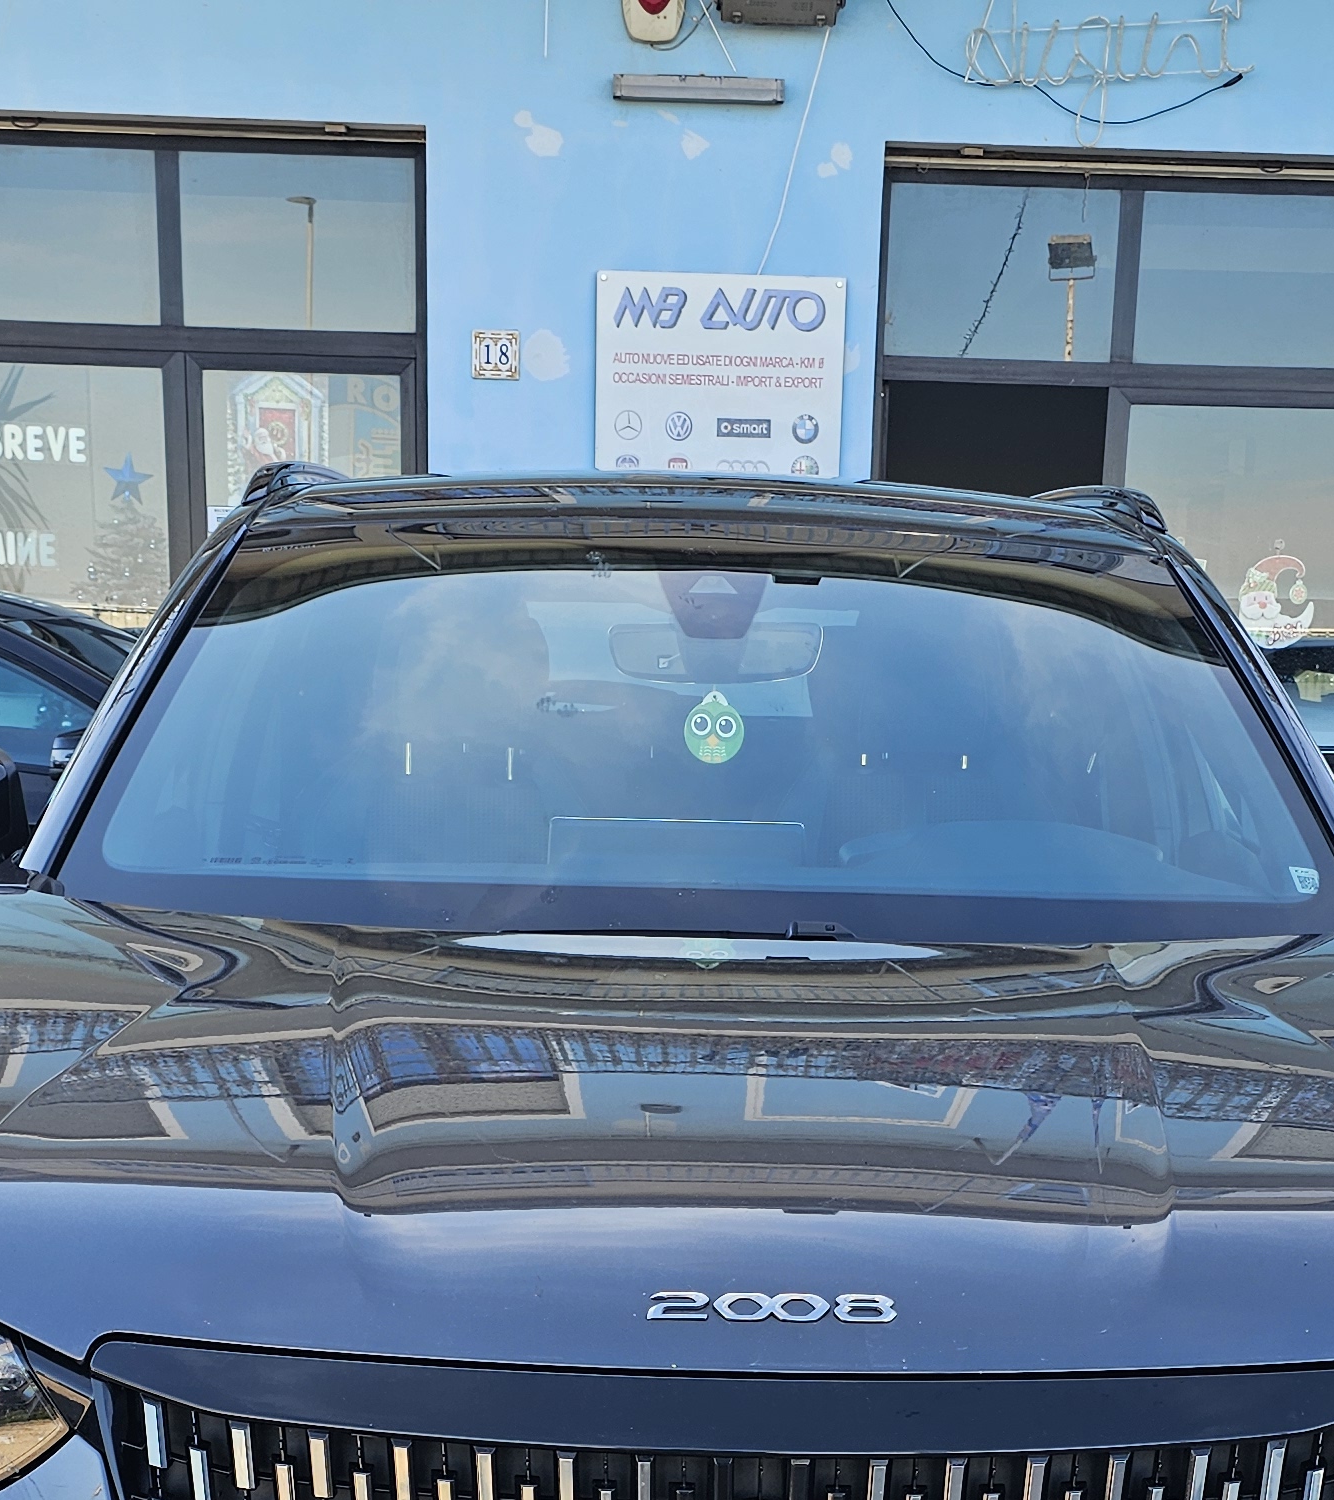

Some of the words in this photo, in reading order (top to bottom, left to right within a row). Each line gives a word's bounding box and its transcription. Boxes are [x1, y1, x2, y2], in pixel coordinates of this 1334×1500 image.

[613, 286, 688, 329] MB
[699, 287, 826, 332] AUTO
[484, 343, 510, 365] 18
[612, 352, 640, 364] AUTO
[641, 353, 675, 365] NUOVE
[676, 354, 690, 366] ED
[691, 354, 722, 366] USATE
[723, 355, 733, 367] DI
[734, 355, 758, 367] OGNI
[759, 356, 795, 368] MARCA
[800, 357, 816, 369] KM
[612, 371, 667, 385] OCCASIONI
[668, 373, 730, 386] SEMESTRALI
[736, 375, 773, 388] IMPORT
[774, 376, 782, 388] &
[784, 376, 824, 389] EXPORT
[732, 422, 768, 434] smart
[646, 1291, 898, 1323] 2008
